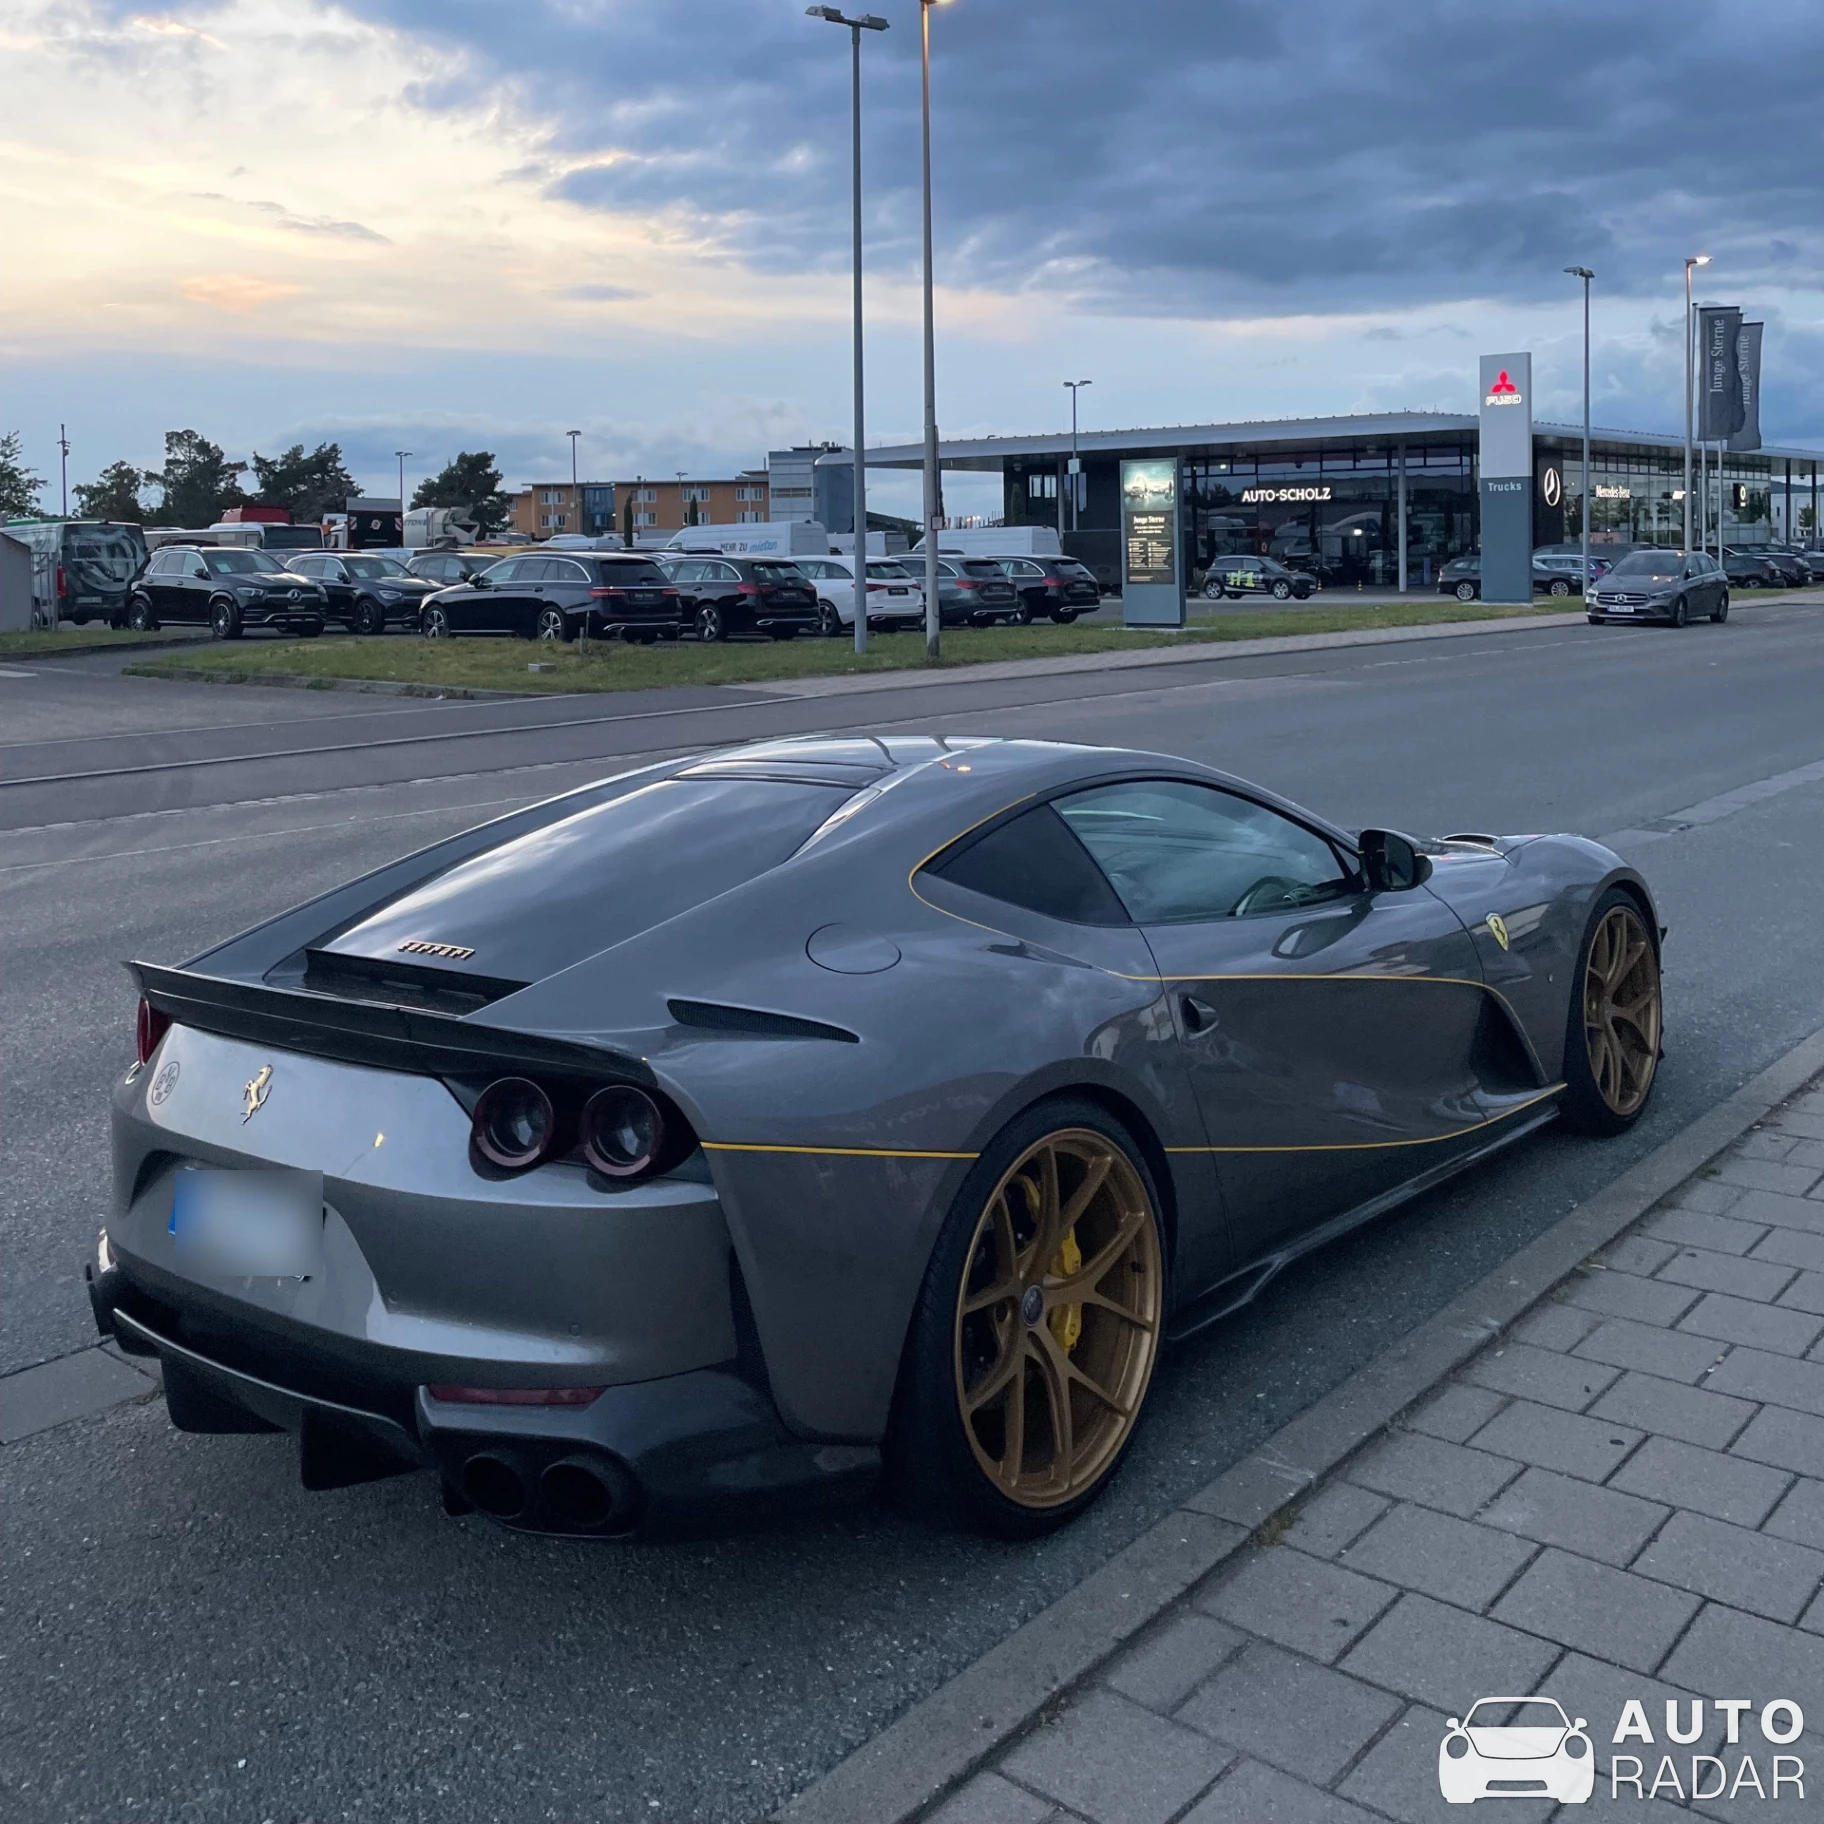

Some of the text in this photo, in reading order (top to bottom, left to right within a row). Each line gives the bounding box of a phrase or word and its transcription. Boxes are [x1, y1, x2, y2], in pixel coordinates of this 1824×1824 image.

[1709, 319, 1725, 392] Junge Sterne
[1738, 334, 1750, 371] Sterne
[1488, 481, 1522, 492] Trucks
[1595, 484, 1631, 499] Mercedes-Benz
[1242, 487, 1331, 503] AUTO-SCHOLZ
[1133, 515, 1165, 525] Junge Sterne
[720, 540, 777, 553] MEHR ZU mieten
